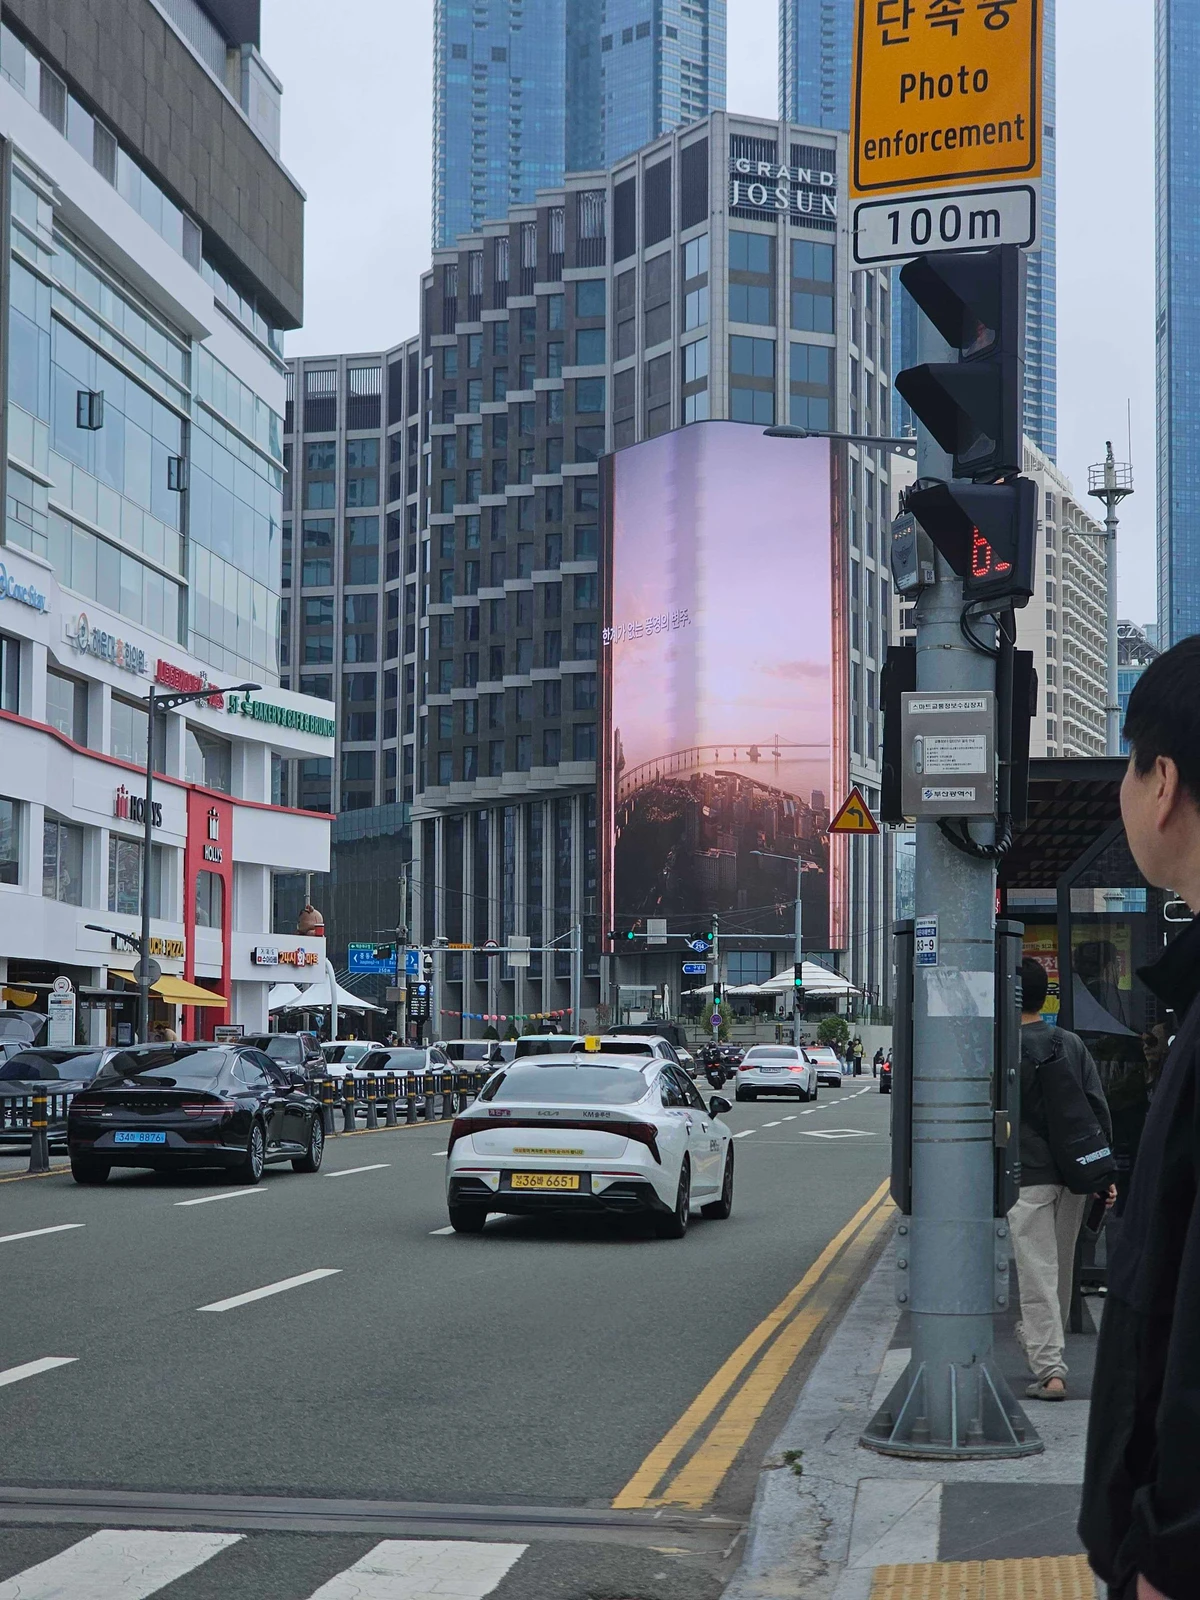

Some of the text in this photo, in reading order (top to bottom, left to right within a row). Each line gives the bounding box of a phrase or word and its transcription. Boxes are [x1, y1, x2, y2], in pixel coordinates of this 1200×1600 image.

[900, 65, 988, 103] Photo
[864, 114, 1025, 160] enforcement
[736, 158, 833, 186] GRAND
[732, 180, 837, 216] JOSUN
[887, 204, 1001, 245] 100m
[602, 624, 626, 646] 한계가
[628, 621, 644, 640] 없는
[645, 612, 669, 636] 풍경의
[253, 701, 280, 726] BAKERY
[310, 715, 335, 738] BRUNCH
[203, 844, 222, 863] HOLLYS
[166, 940, 184, 957] PIZZA
[139, 1133, 161, 1142] 8876
[546, 1176, 574, 1187] 6651
